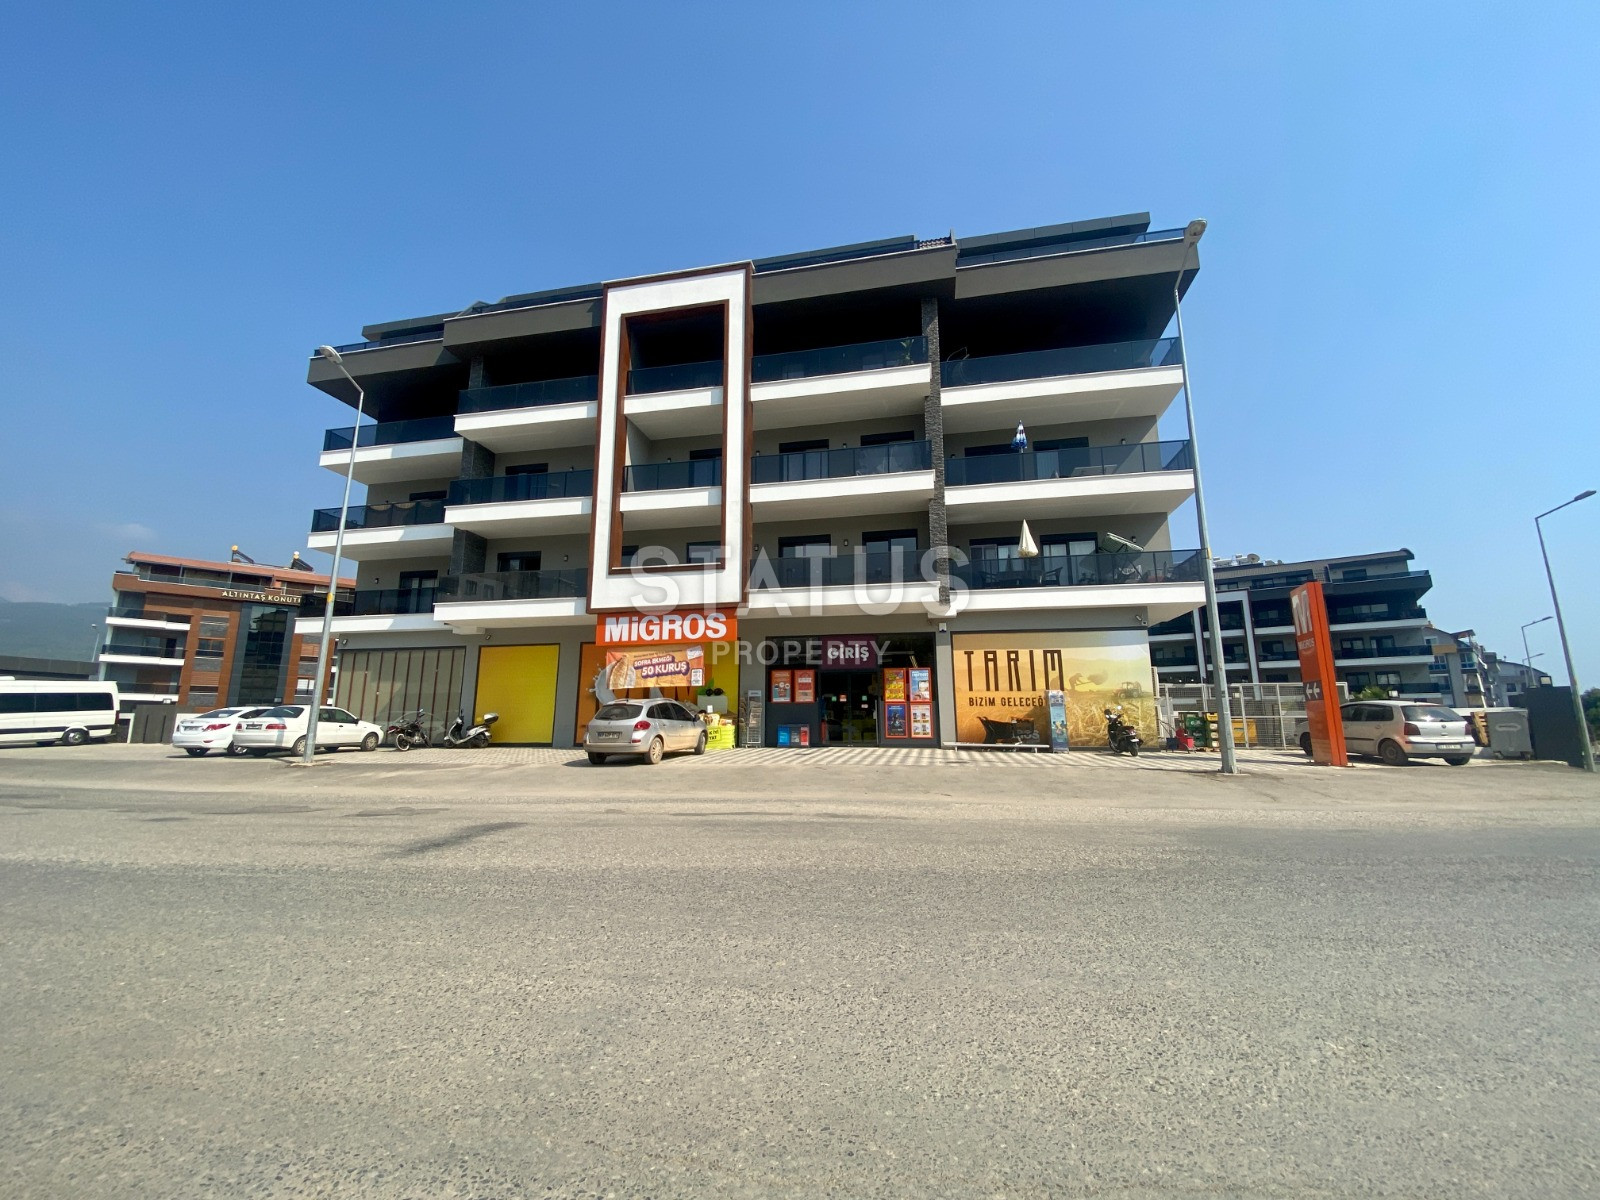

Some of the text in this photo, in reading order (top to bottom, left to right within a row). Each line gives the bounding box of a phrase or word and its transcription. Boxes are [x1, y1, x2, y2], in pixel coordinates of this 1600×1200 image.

[827, 643, 870, 662] GİRİŞ
[641, 661, 687, 676] 50 KURUŞ
[963, 649, 1065, 692] TARIM
[968, 696, 996, 707] BİZİM
[1001, 695, 1045, 707] GELECEĞ
